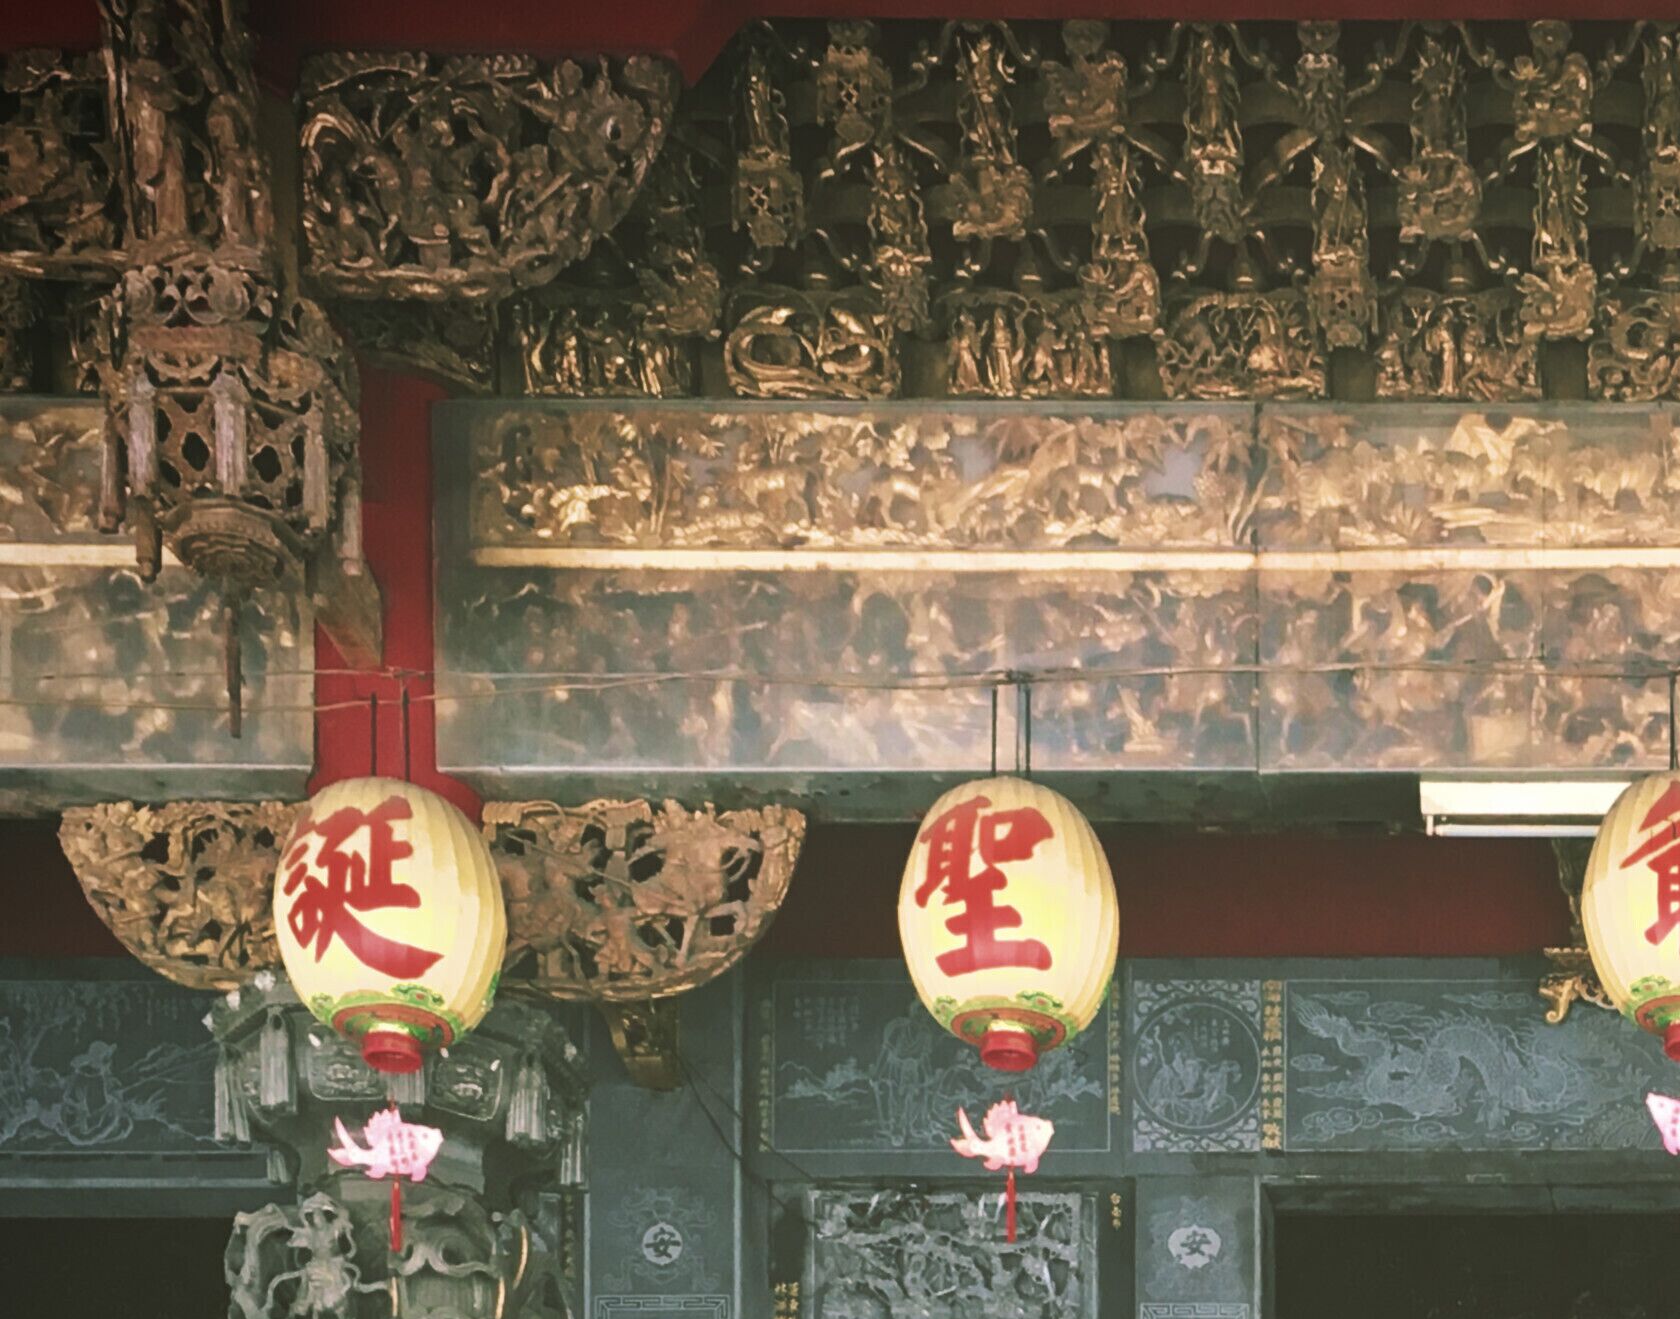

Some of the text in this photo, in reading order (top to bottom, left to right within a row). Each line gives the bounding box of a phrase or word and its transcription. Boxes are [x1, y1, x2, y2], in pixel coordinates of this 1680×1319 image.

[283, 794, 443, 979] 誕
[915, 795, 1055, 977] 聖
[645, 1227, 681, 1259] 安
